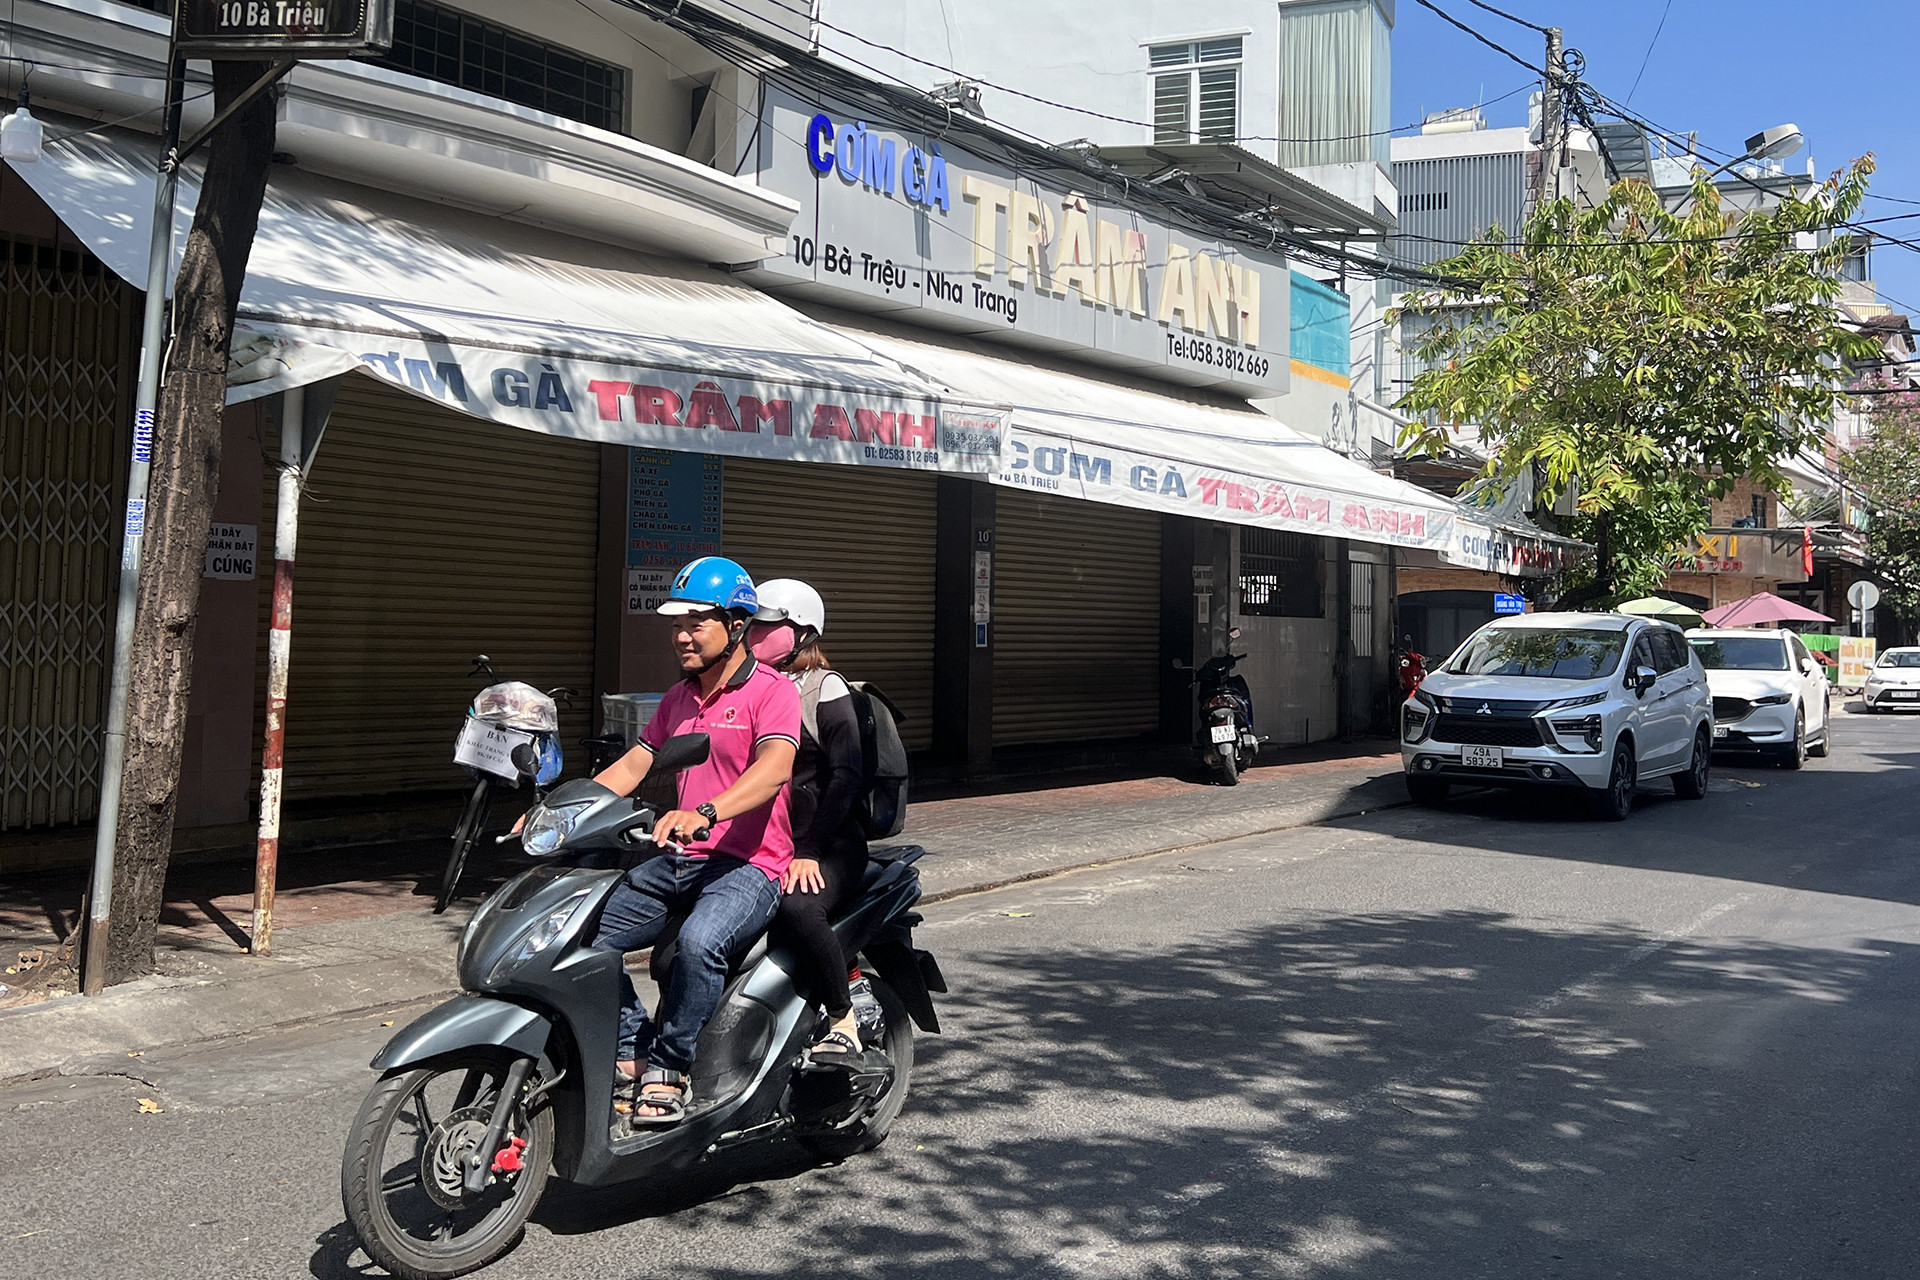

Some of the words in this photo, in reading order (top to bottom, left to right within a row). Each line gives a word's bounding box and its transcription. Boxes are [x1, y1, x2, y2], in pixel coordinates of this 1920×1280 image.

[220, 2, 242, 27] 10
[246, 1, 270, 27] Bà
[276, 1, 325, 31] Triệu
[807, 113, 896, 196] CƠM
[902, 141, 950, 212] GÀ
[962, 175, 1147, 317] TRÂM
[1159, 243, 1261, 348] ANH
[793, 235, 814, 267] 10
[824, 243, 852, 276] Bà
[861, 252, 906, 294] Triệu
[926, 270, 963, 304] Nha
[972, 282, 1018, 323] Trang
[360, 351, 468, 402] ƠM
[490, 363, 573, 413] GÀ
[587, 379, 793, 437] TRÂM
[808, 403, 938, 449] ANH
[879, 447, 904, 461] 02583
[906, 449, 922, 462] 812
[923, 451, 939, 464] 669
[1014, 472, 1028, 485] BÀ
[1031, 475, 1059, 491] TRIỆU
[1130, 465, 1188, 498] GÀ
[1197, 476, 1331, 524] TRÂM
[1340, 503, 1426, 538] ANH
[209, 527, 219, 538] ẠI
[221, 526, 242, 538] ĐÂY
[234, 540, 255, 553] ĐẶT
[212, 553, 253, 575] CÚNG
[1466, 756, 1499, 767] 583.25
[1473, 747, 1491, 757] 49A
